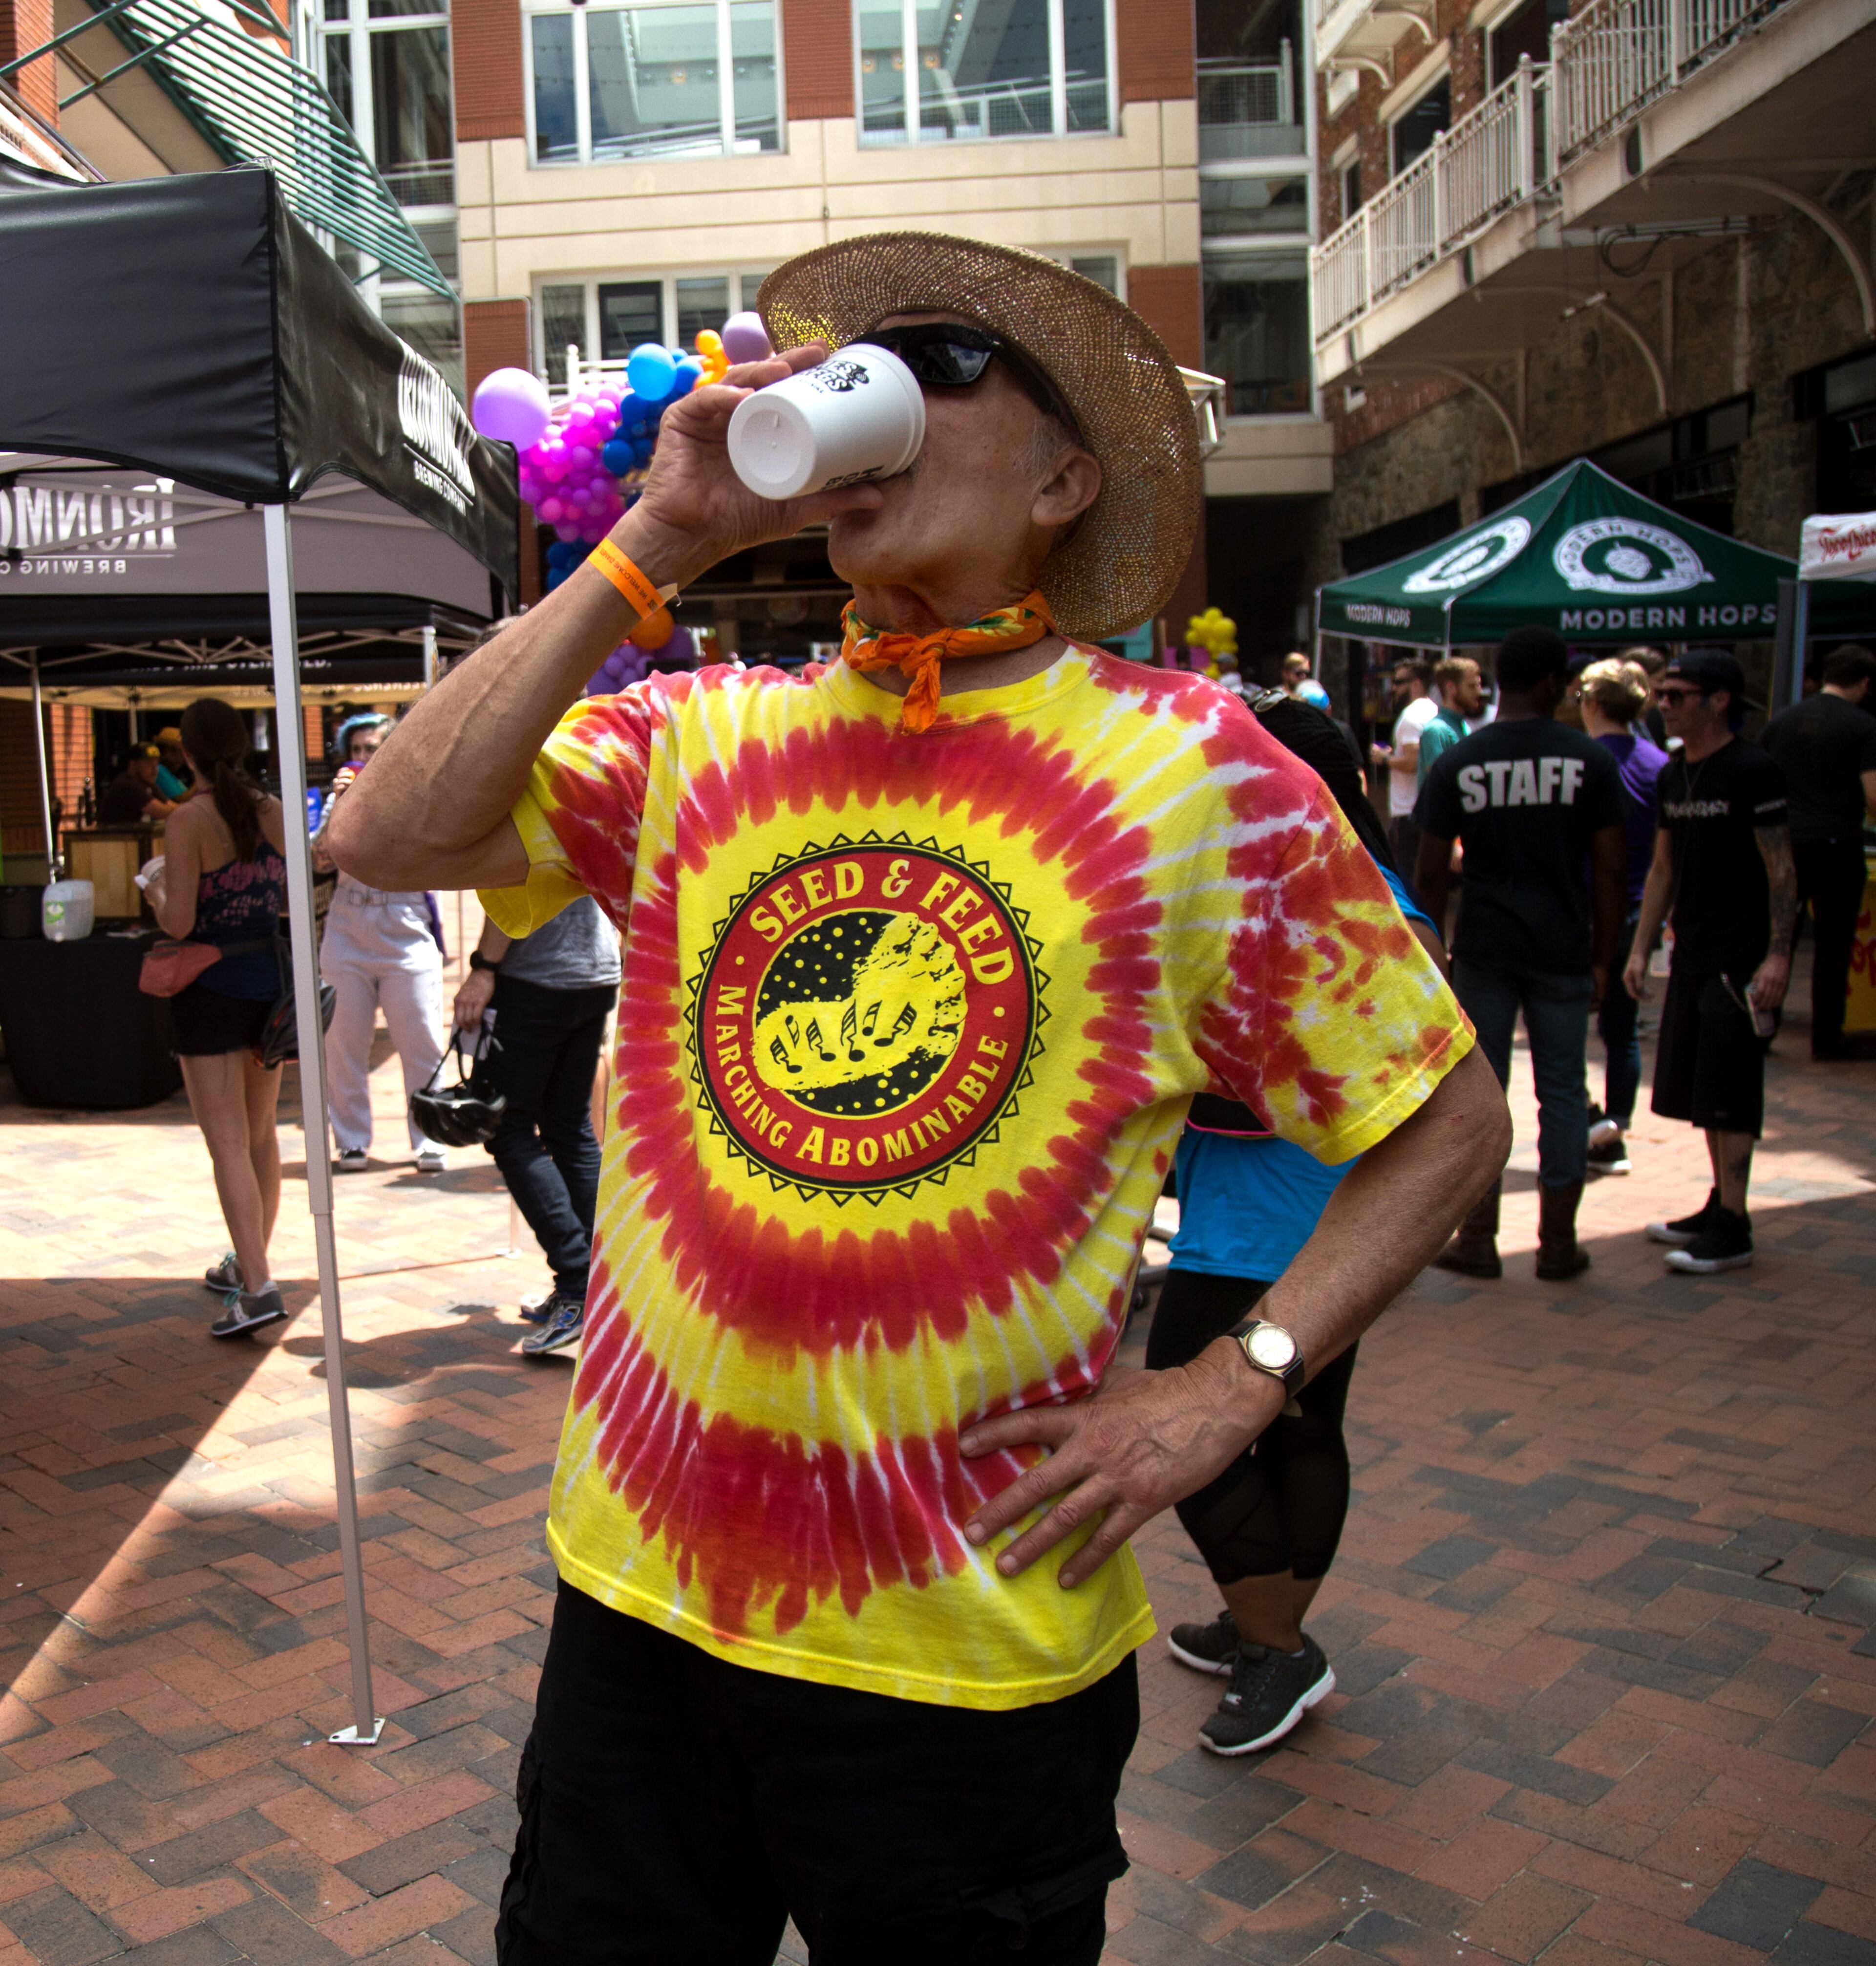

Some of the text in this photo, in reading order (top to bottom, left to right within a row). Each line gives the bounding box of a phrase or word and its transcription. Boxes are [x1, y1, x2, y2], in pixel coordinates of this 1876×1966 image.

[613, 562, 640, 592] WELCOME
[1347, 603, 1411, 628] MODERN HOPS
[1560, 604, 1777, 631] MODERN HOPS
[1457, 756, 1585, 813] STAFF
[749, 858, 1014, 985] SEED & FEED
[715, 983, 1009, 1167] MARCHING ABOMINABLE
